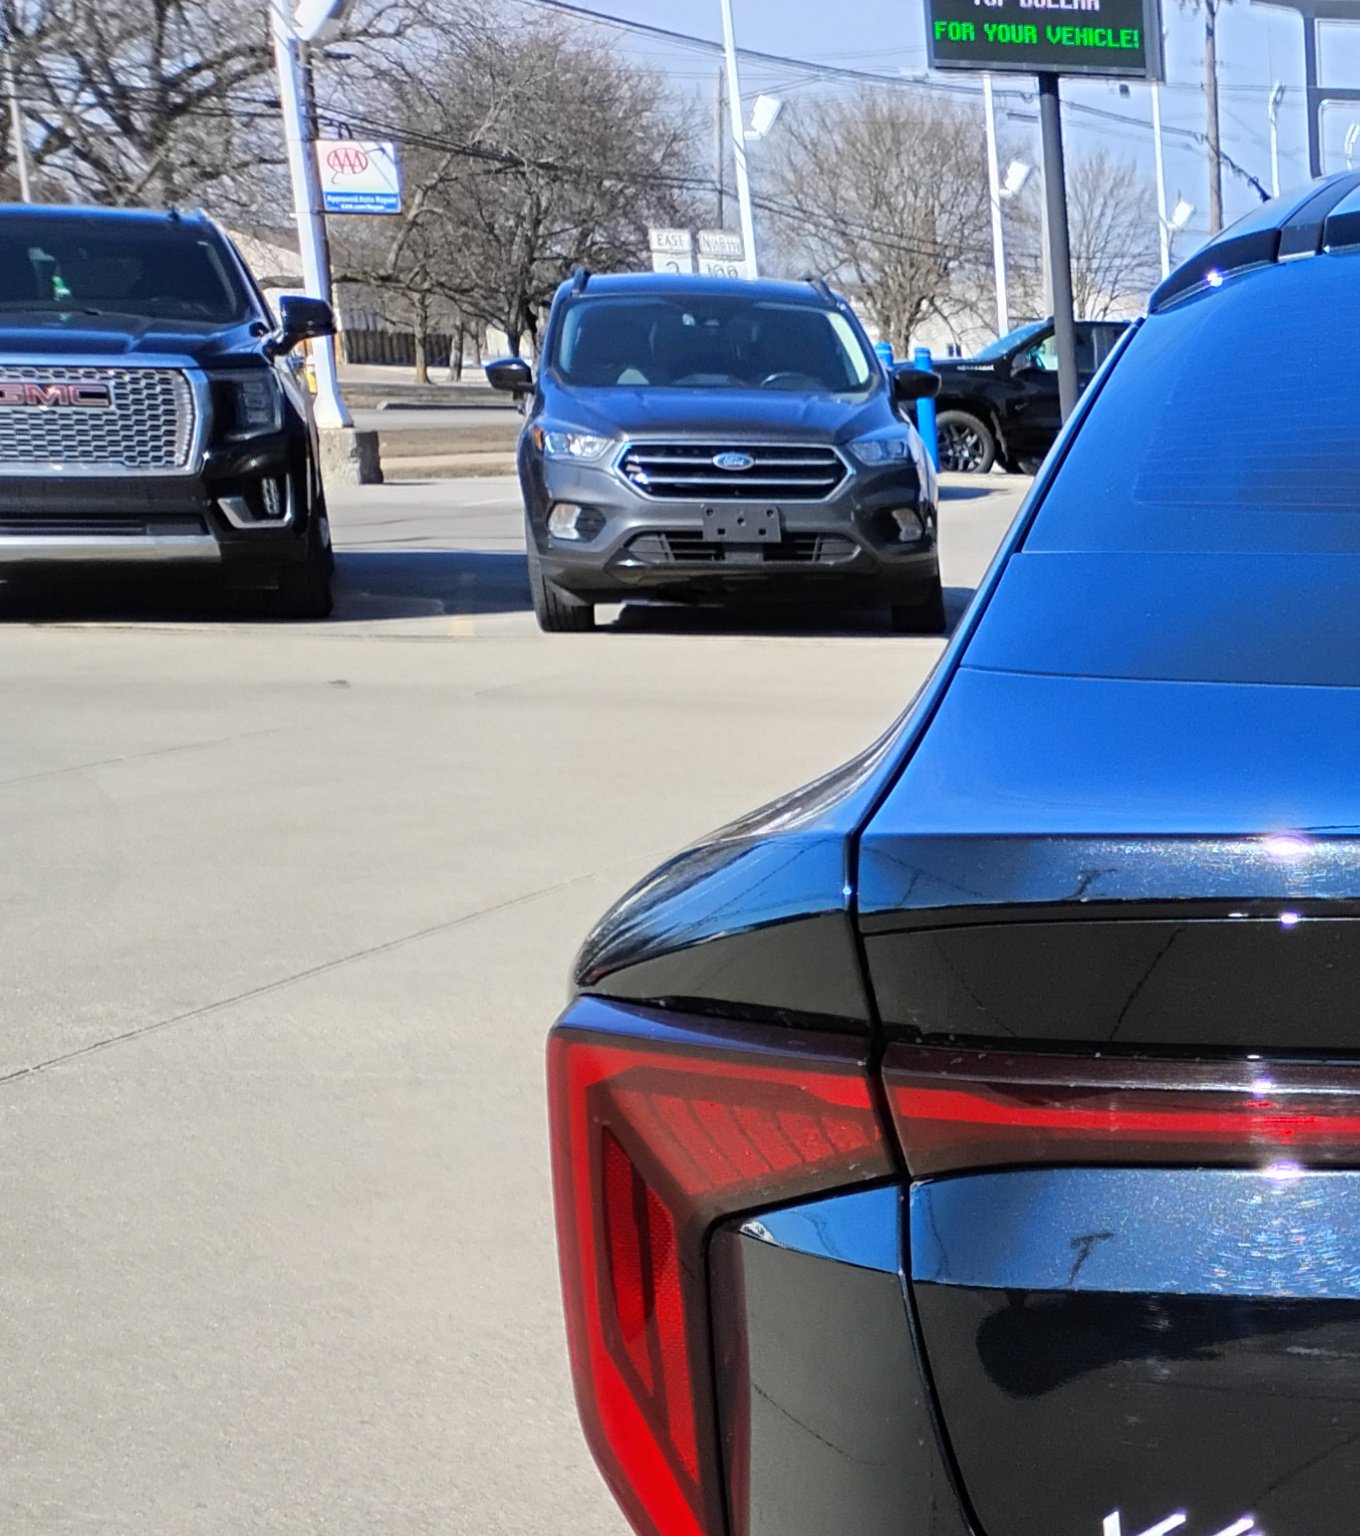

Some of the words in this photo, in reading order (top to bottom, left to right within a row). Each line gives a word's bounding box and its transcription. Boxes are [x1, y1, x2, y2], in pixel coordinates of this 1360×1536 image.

[934, 20, 975, 42] FOR
[984, 23, 1037, 44] YOUR
[1046, 25, 1140, 49] VEHICLE!
[331, 149, 366, 174] AAA
[657, 233, 684, 247] EAST
[0, 383, 110, 406] GMC
